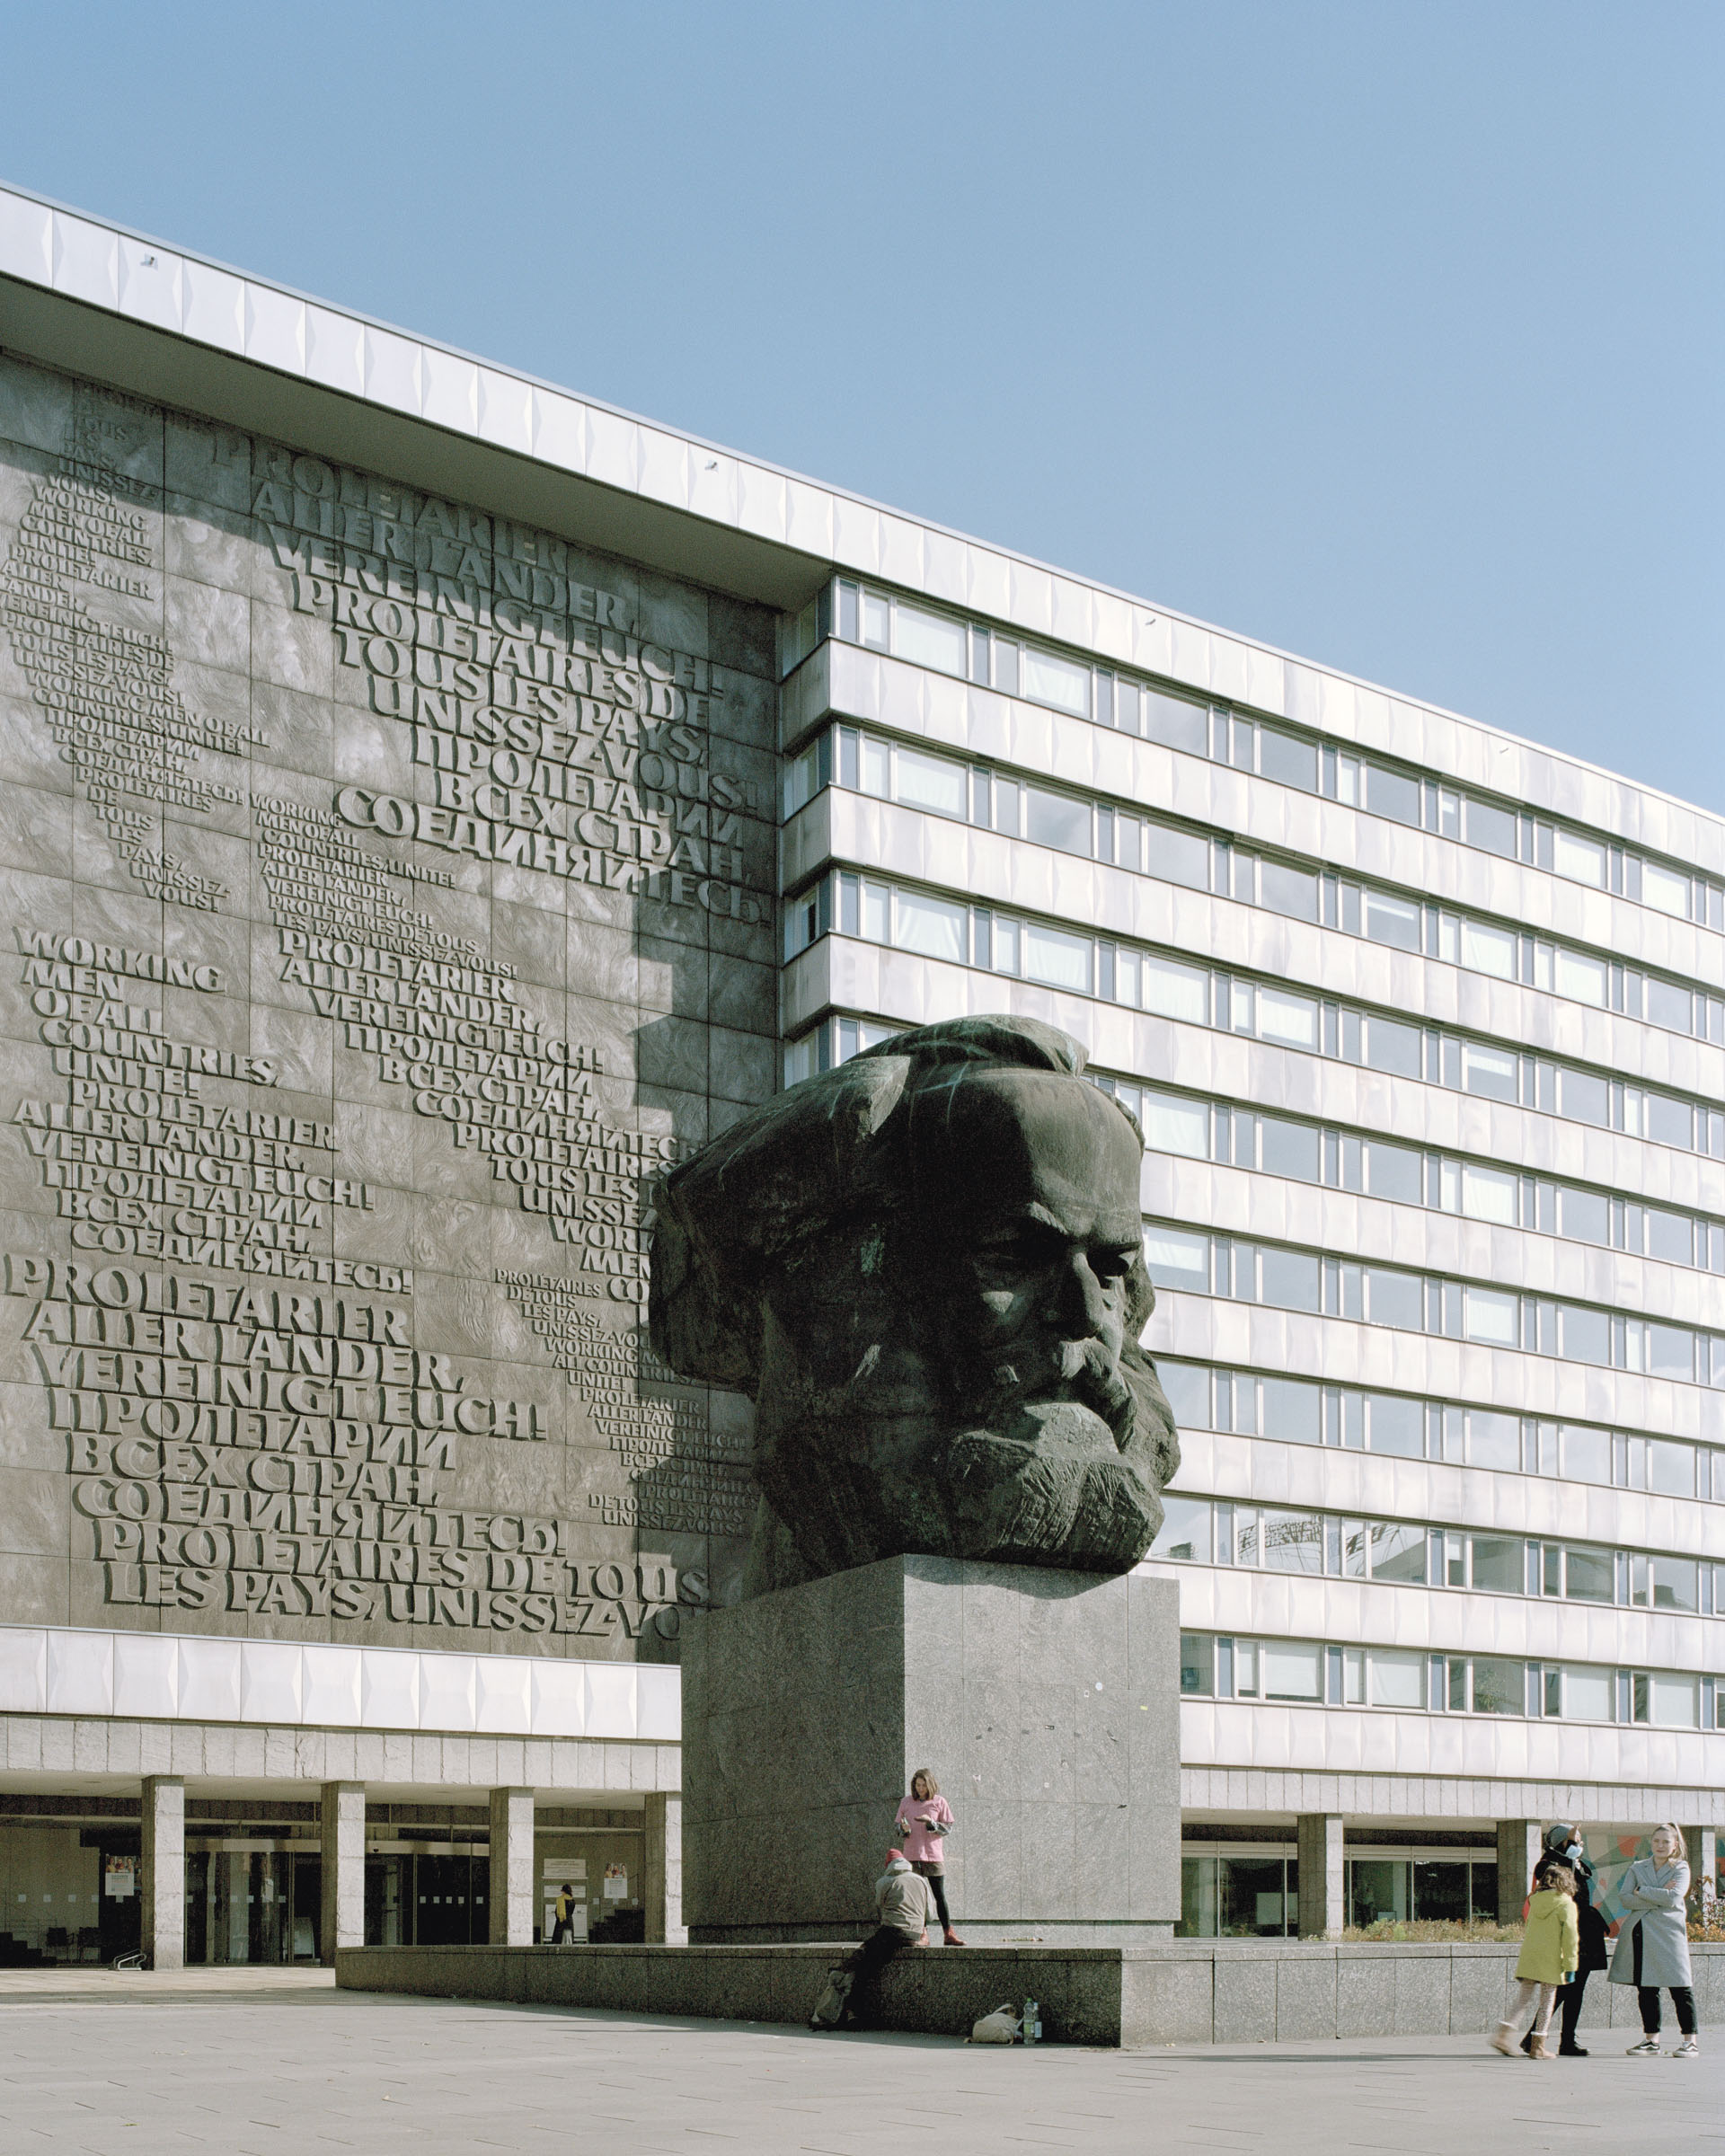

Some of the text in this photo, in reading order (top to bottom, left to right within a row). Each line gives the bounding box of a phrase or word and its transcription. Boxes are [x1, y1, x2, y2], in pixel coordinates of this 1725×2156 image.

[32, 483, 146, 531] WORKING
[48, 473, 116, 507] VOUS!
[28, 500, 81, 529] MEN
[86, 517, 118, 540] OF
[252, 481, 413, 568] ALLER
[18, 529, 95, 567] UNITE!
[0, 560, 69, 592] ALLER
[8, 542, 154, 601] PROLETARIER
[267, 525, 724, 701] VEREINIGT EUCH!
[9, 631, 73, 660] TOUS
[75, 647, 109, 670] LES
[147, 652, 174, 672] DE
[334, 623, 490, 706] TOUS
[491, 674, 568, 726] LES
[24, 669, 145, 721] WORKING
[149, 701, 198, 729] MEN
[204, 718, 237, 737] OF
[641, 678, 710, 728] DE
[46, 706, 199, 761] ПРОЛЕТАРИИ
[52, 725, 111, 753] ВСЕХ
[168, 721, 243, 756] UNITE!
[87, 785, 118, 806] DE
[410, 720, 744, 849] ПРОЛЕТАРИИ
[435, 770, 566, 837] ВСЕХ
[94, 803, 155, 831] TOUS
[250, 792, 343, 828] WORKING
[256, 813, 303, 835] MEN
[305, 824, 330, 842] OF
[108, 823, 145, 846] LES
[119, 842, 184, 872] PAYS,
[259, 844, 390, 888] PROLETARIER
[261, 862, 322, 887] ALLER
[388, 860, 456, 888] UNITE!
[144, 879, 220, 913] VOUS!
[264, 877, 433, 929] VEREINIGT EUCH!
[273, 910, 310, 932] LES
[400, 925, 423, 943] DE
[424, 931, 481, 956] TOUS
[12, 925, 226, 994] WORKING
[21, 959, 124, 1002] MEN
[279, 927, 518, 1003] PROLETARIER
[280, 959, 390, 1003] ALLER
[31, 989, 169, 1039] OF ALL
[309, 987, 604, 1074] VEREINIGT EUCH!
[52, 1047, 199, 1098] UNITE!
[345, 1021, 592, 1096] ПРОЛЕТАРИИ
[380, 1055, 478, 1098] ВСЕХ
[12, 1098, 141, 1144] ALLER
[67, 1080, 341, 1152] PROLETARIER
[21, 1125, 375, 1211] VEREINIGT EUCH!
[489, 1153, 578, 1193] TOUS
[583, 1171, 639, 1204] LES
[40, 1159, 322, 1229] ПРОЛЕТАРИИ
[56, 1188, 165, 1230] ВСЕХ
[71, 1221, 413, 1292] СОЕДИНЯЙТЕСЬ!
[4, 1253, 412, 1348] PROLETARIER
[508, 1285, 576, 1309] DE TOUS
[522, 1303, 602, 1329] LES PAYS,
[21, 1301, 206, 1362] ALLER
[545, 1337, 638, 1362] WORKING
[553, 1354, 583, 1372] ALL
[567, 1370, 626, 1392] UNITE!
[32, 1342, 547, 1439] VEREINIGT EUCH!
[581, 1387, 700, 1415] PROLETARIER
[588, 1402, 639, 1423] ALLER
[48, 1388, 456, 1471] ПРОЛЕТАРИИ
[595, 1418, 689, 1444] VEREINIGT
[66, 1432, 238, 1489] ВСЕХ
[72, 1477, 568, 1557] СОЕДИНЯЙТЕСЬ!
[588, 1492, 615, 1509] DE
[614, 1495, 665, 1515] TOUS
[103, 1560, 223, 1613] LES
[226, 1569, 385, 1624] PAYS,
[488, 1551, 561, 1597] DE
[562, 1559, 711, 1607] TOUS
